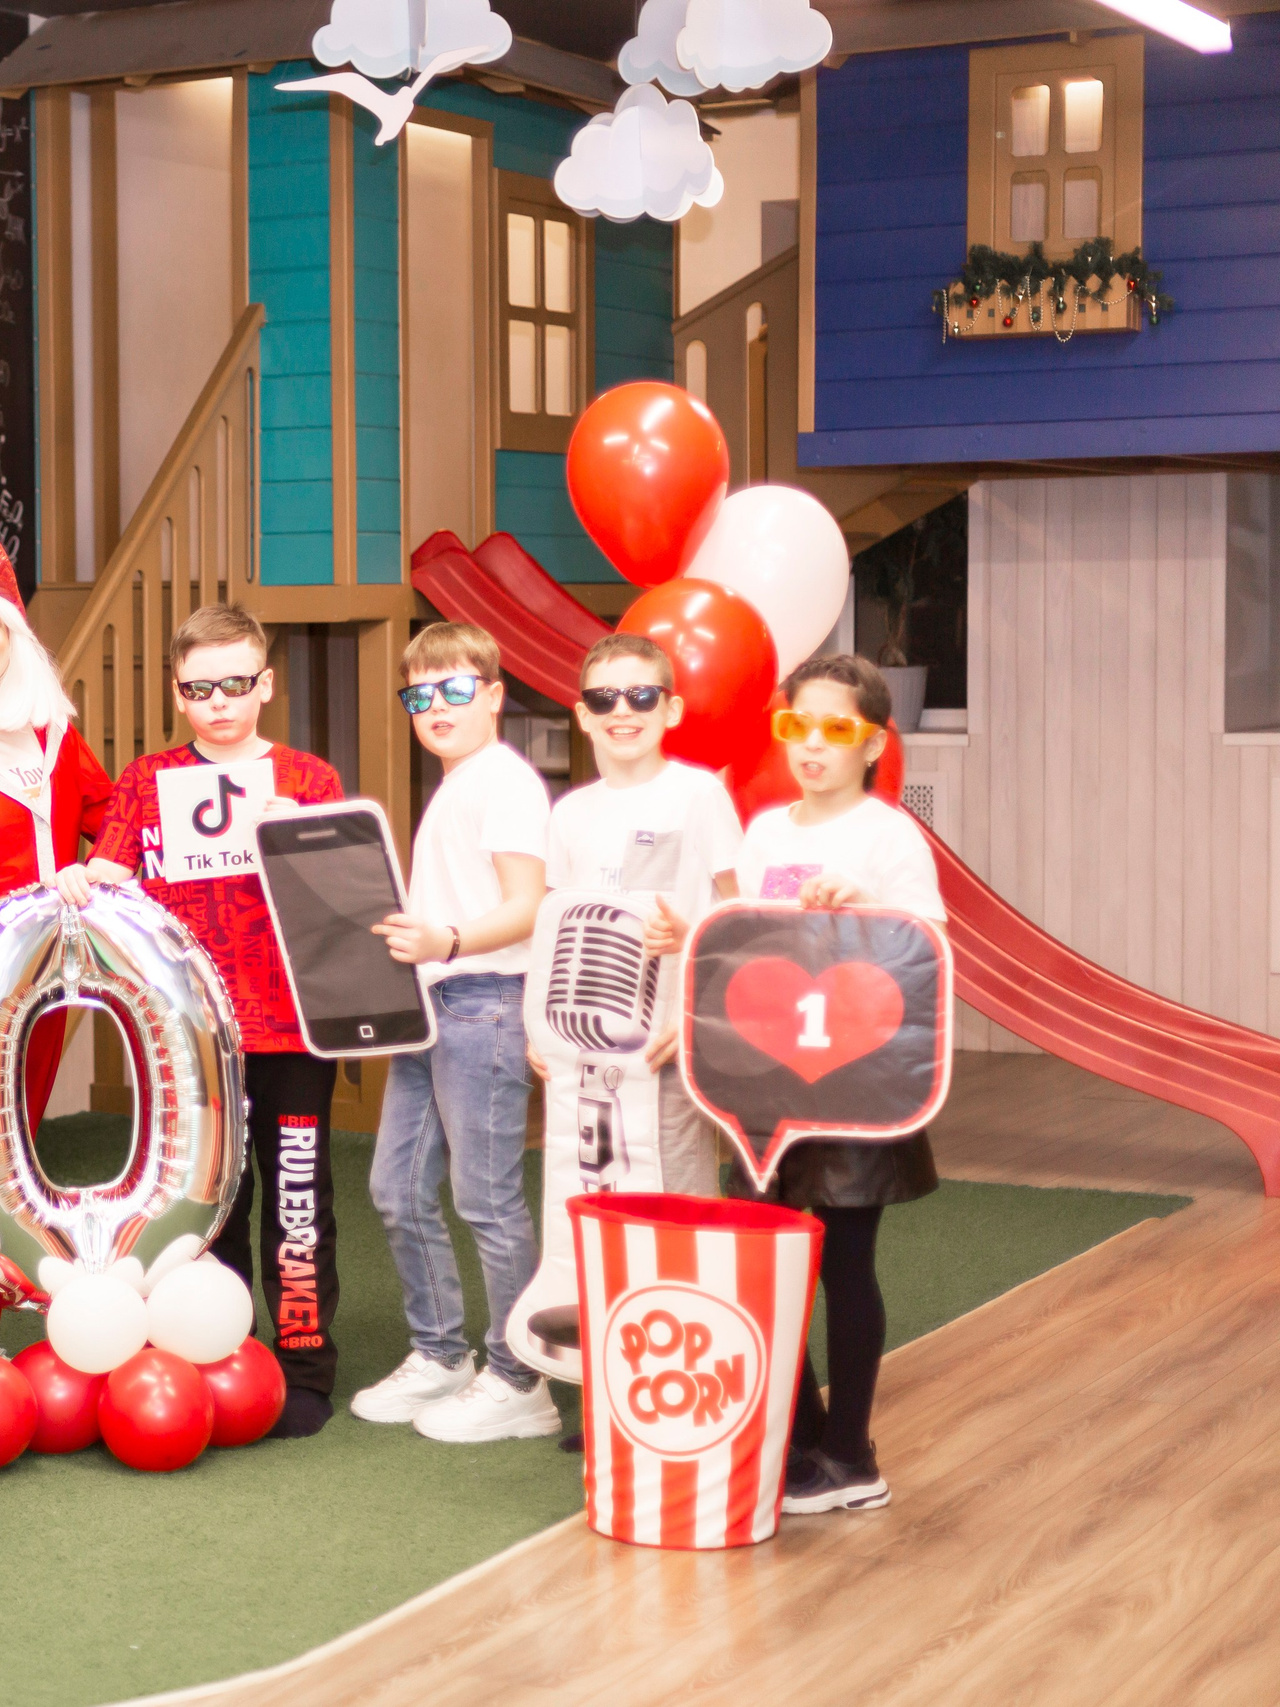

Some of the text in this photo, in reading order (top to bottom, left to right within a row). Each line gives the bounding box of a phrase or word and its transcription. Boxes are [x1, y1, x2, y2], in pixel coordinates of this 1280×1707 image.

[184, 850, 254, 871] Tik Tok
[796, 993, 830, 1048] 1
[278, 1115, 318, 1128] #BRO
[278, 1126, 320, 1337] RULEBREAKER
[279, 1335, 323, 1349] #BRO
[620, 1309, 713, 1376] POP
[627, 1353, 745, 1428] CORN
